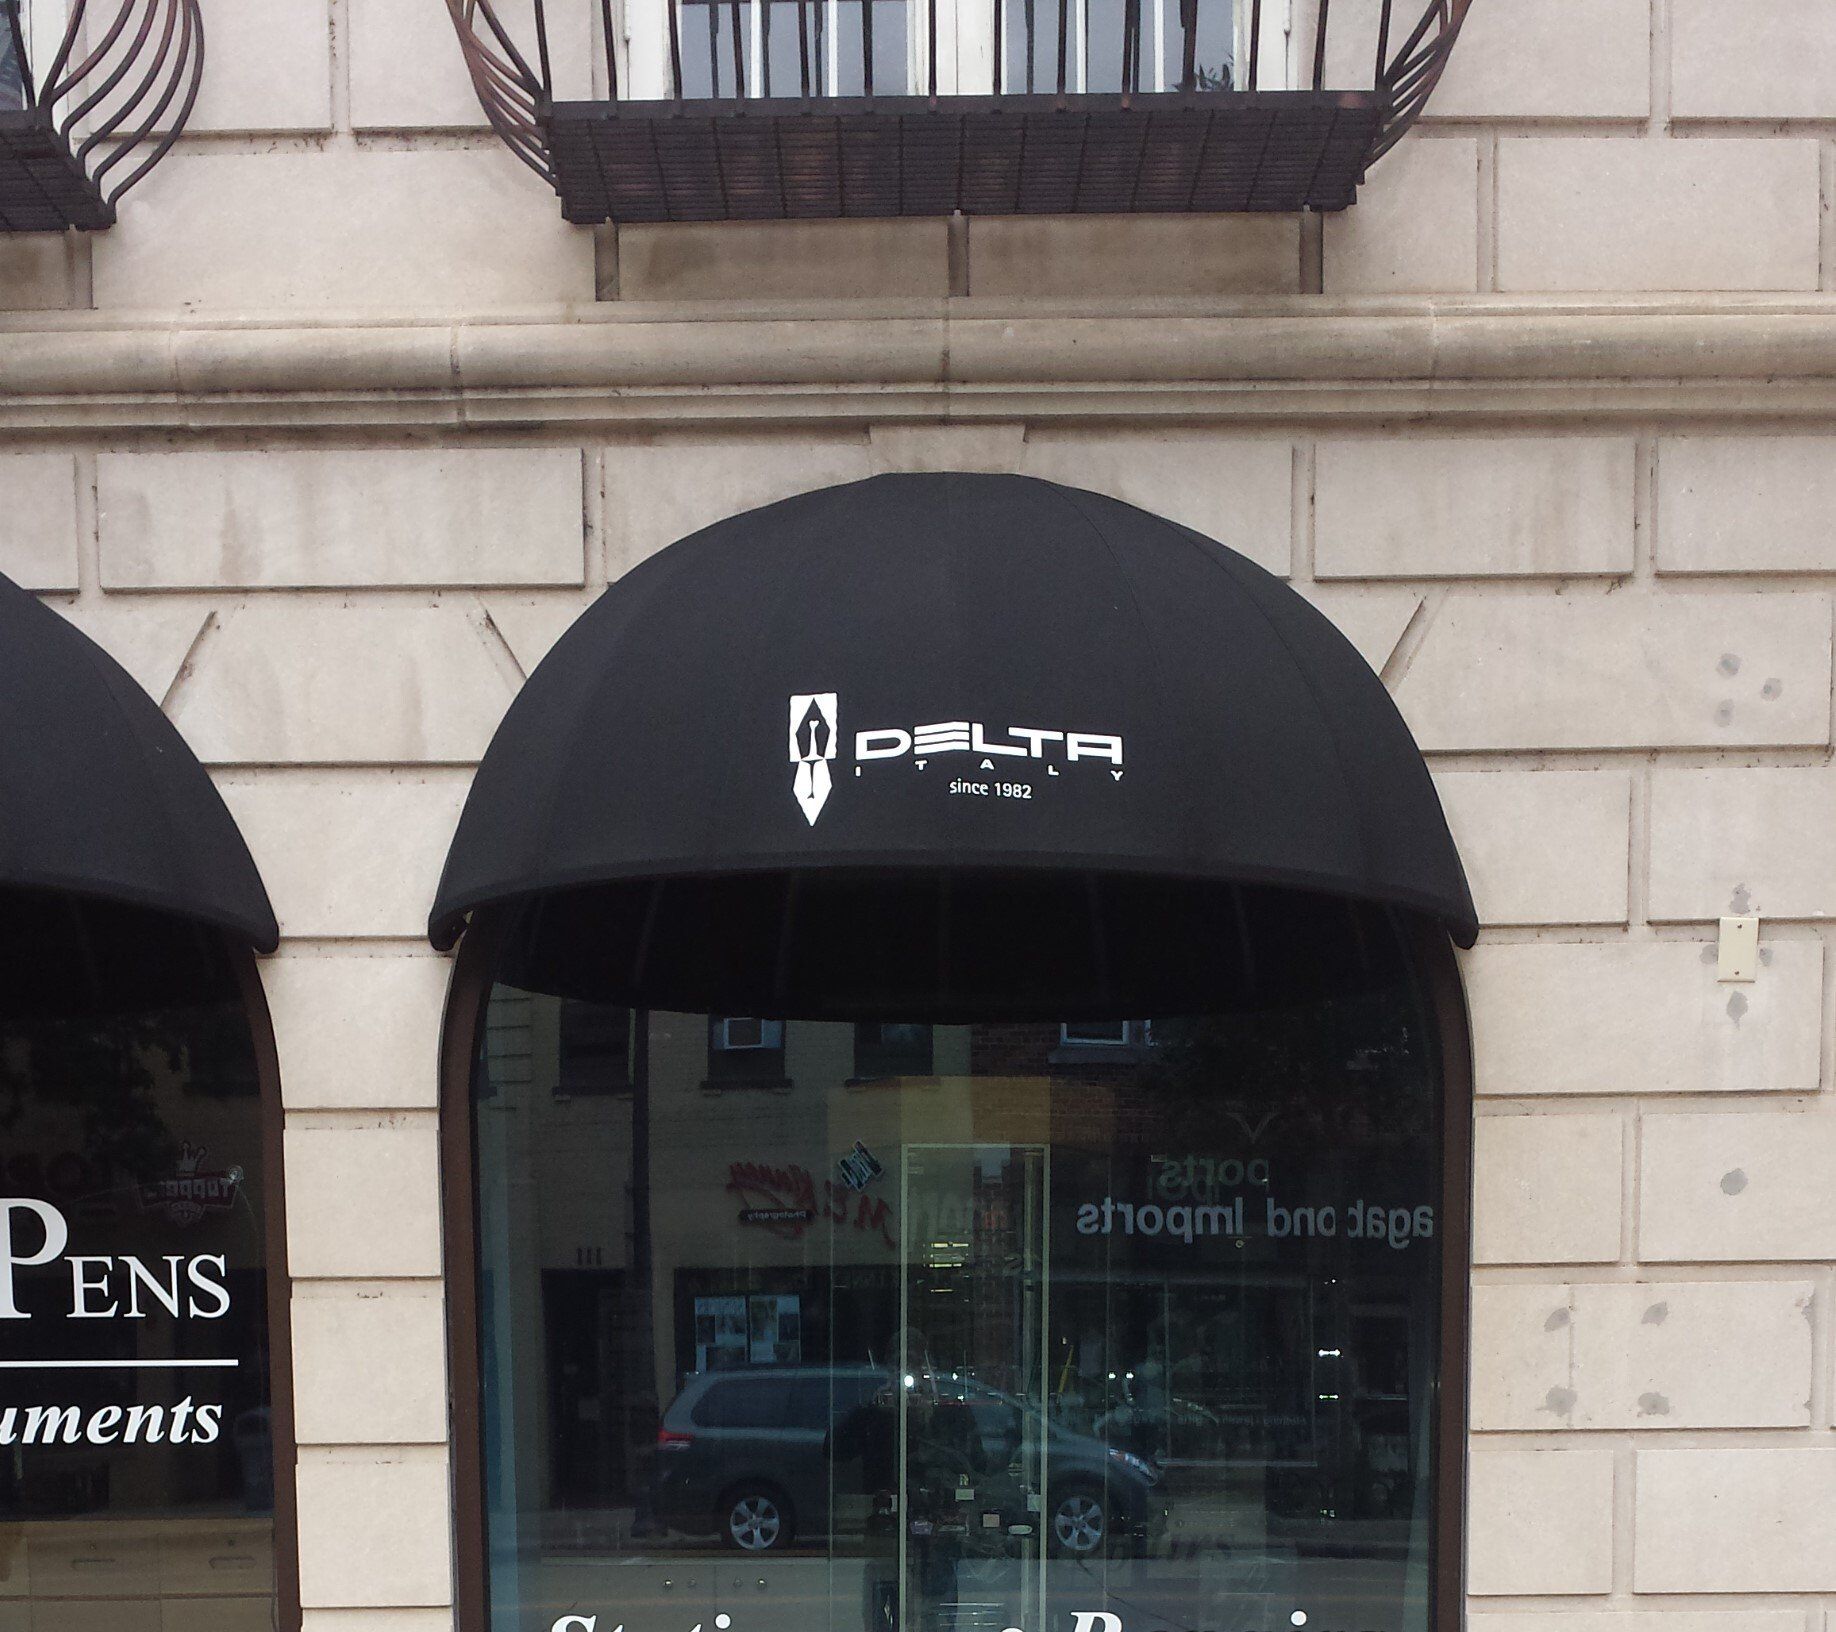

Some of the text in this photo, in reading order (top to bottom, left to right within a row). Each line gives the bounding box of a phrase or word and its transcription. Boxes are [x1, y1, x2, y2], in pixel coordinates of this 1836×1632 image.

[856, 721, 1124, 765] DELTA
[856, 759, 1124, 782] ITALY
[949, 777, 1032, 799] since 1982
